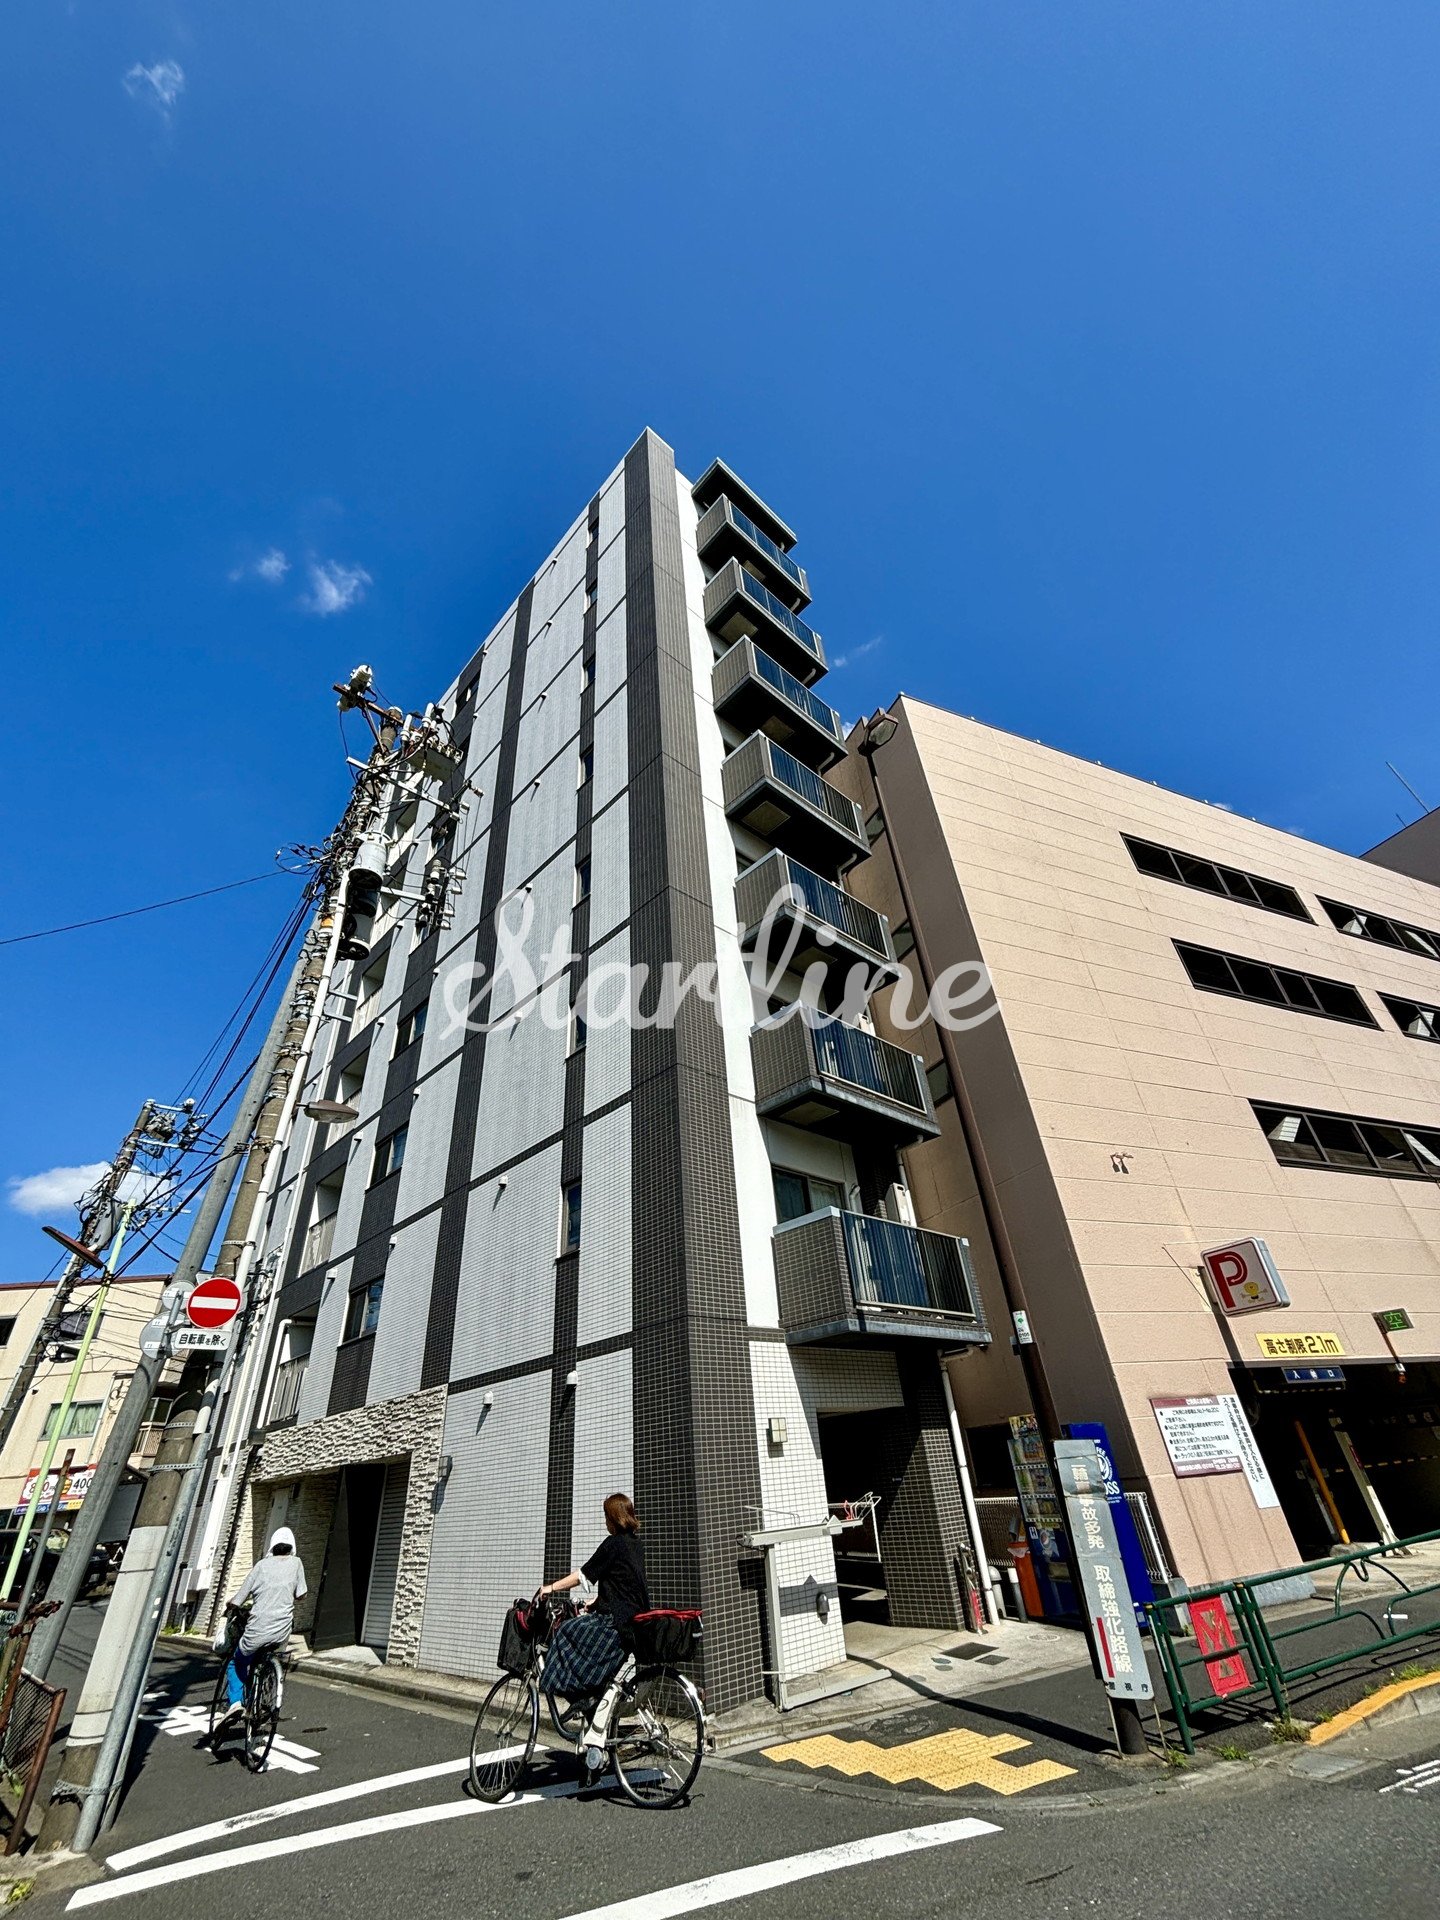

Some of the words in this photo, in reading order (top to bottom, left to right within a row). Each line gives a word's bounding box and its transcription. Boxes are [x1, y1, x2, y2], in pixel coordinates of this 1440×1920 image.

[1207, 1250, 1248, 1309] P
[178, 1333, 226, 1347] 自転車を除く
[1094, 1565, 1134, 1673] 取締強化路線
